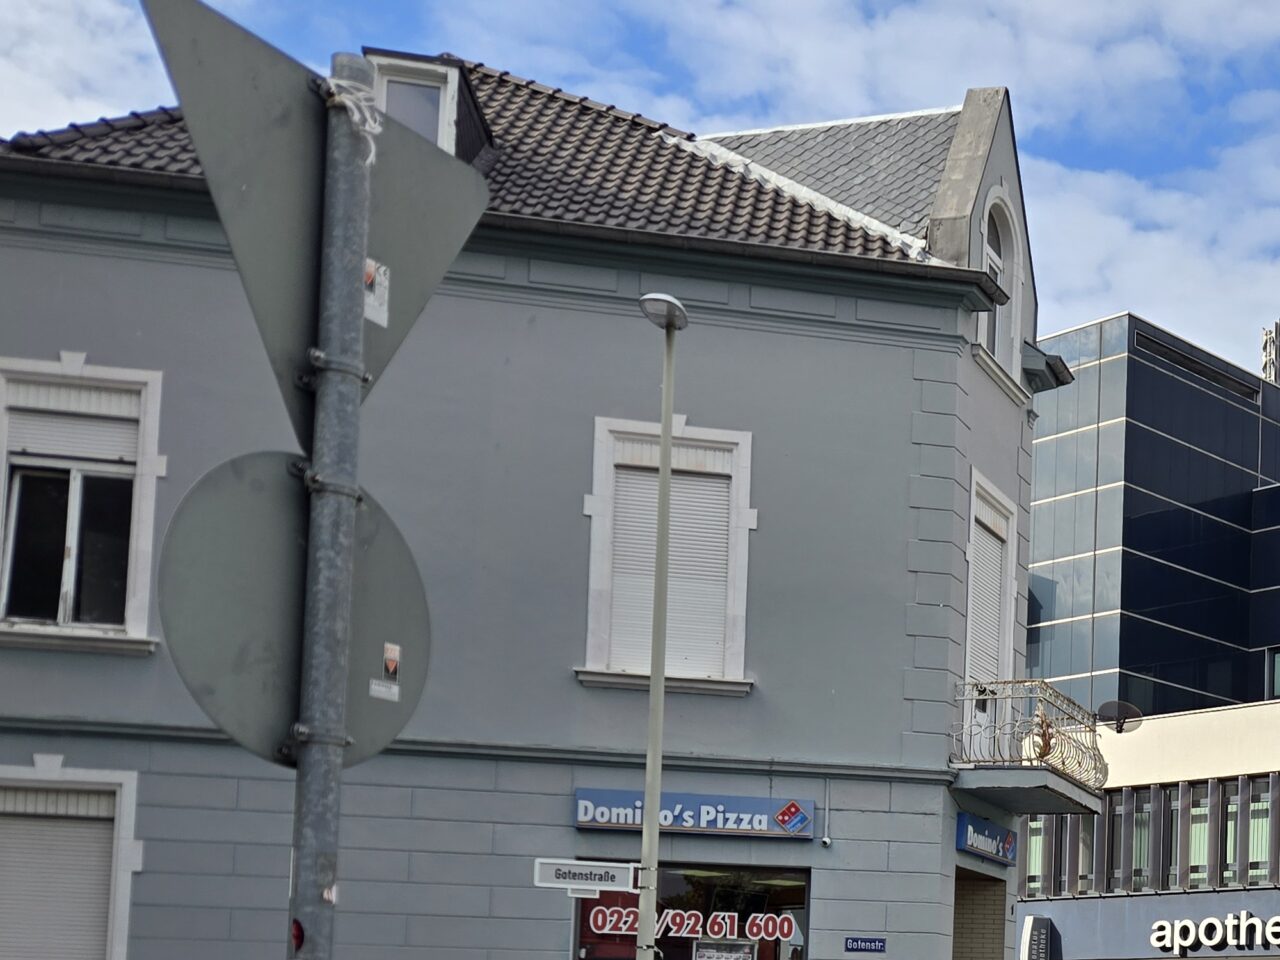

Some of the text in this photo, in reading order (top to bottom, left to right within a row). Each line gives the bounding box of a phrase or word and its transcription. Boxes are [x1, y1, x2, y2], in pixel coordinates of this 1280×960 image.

[577, 799, 694, 827] Domio's
[700, 805, 768, 831] Pizza
[967, 824, 1003, 857] Domino's
[554, 868, 616, 883] Gotenstraße
[589, 906, 796, 941] 022/92 61 600
[847, 939, 885, 950] Gotenstr.
